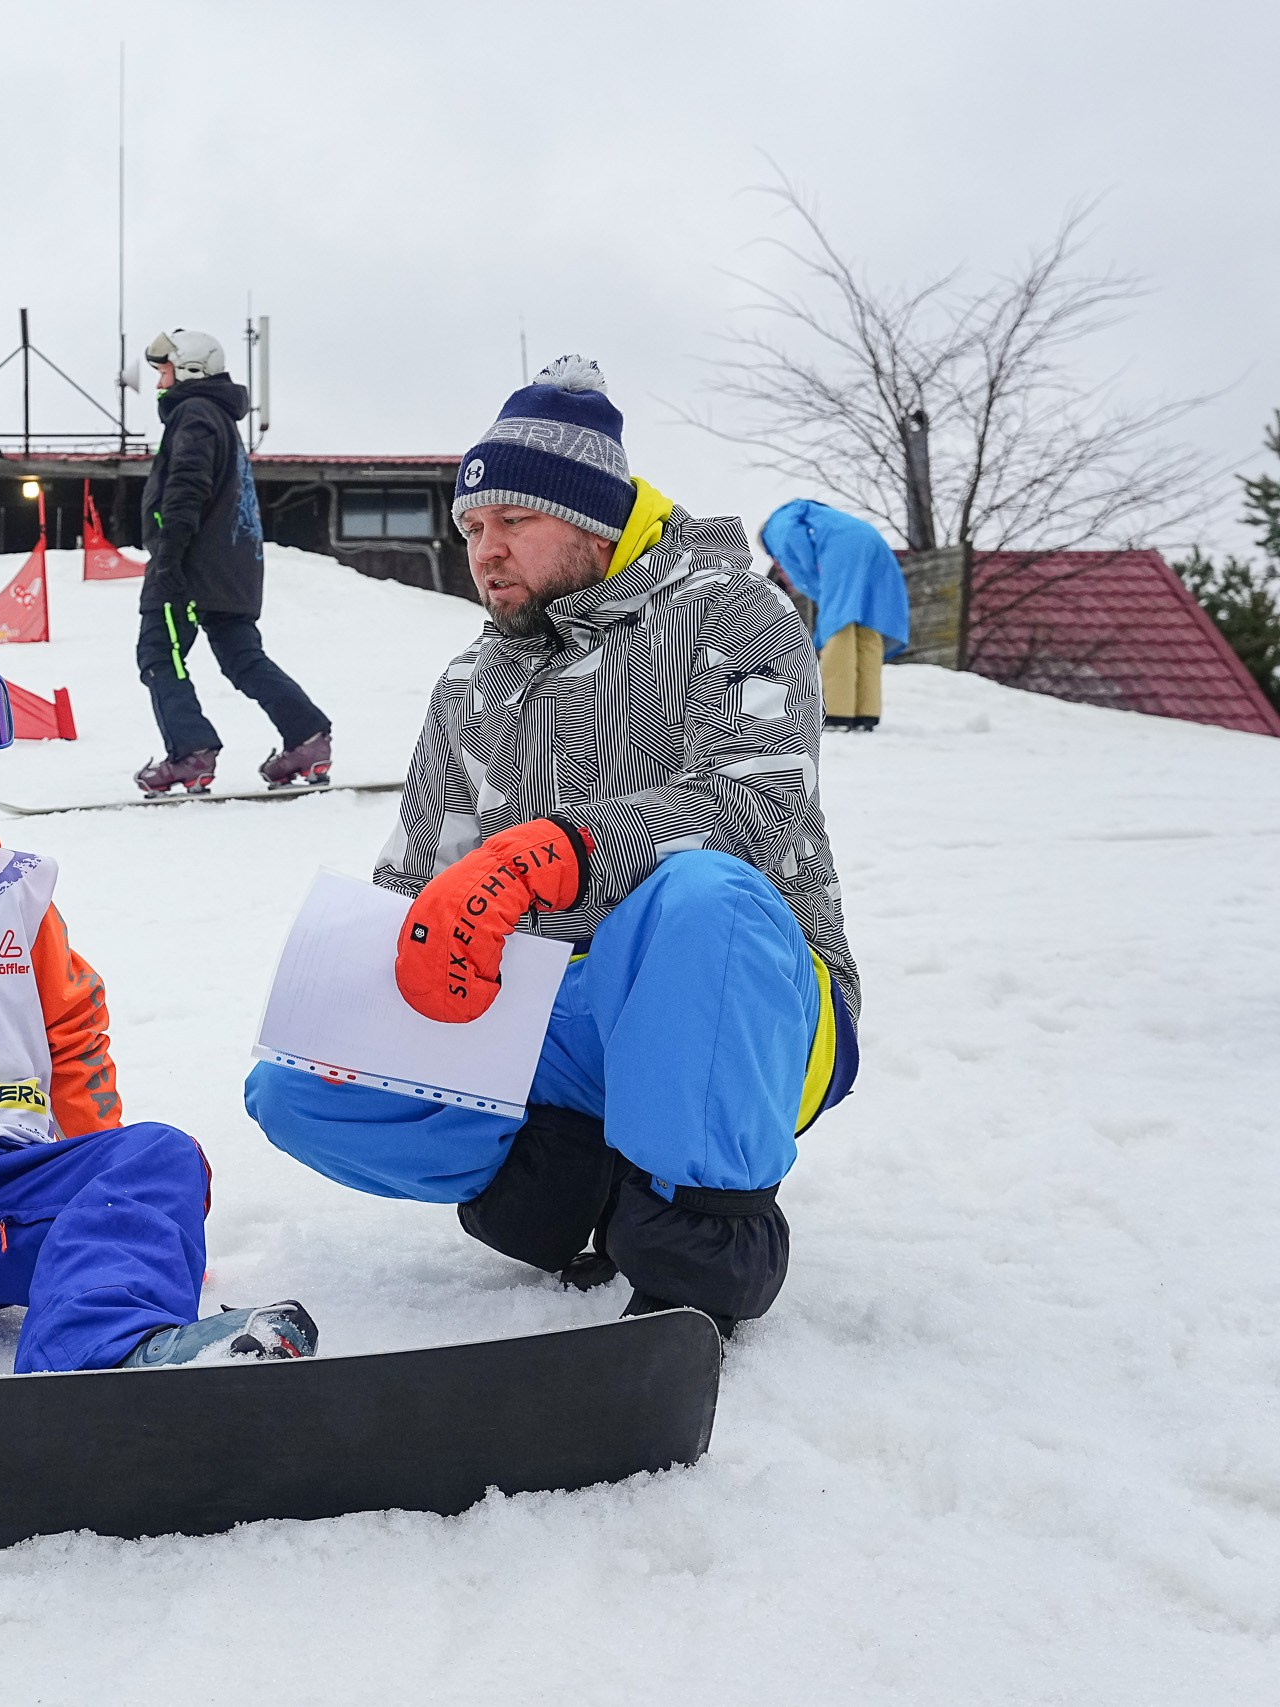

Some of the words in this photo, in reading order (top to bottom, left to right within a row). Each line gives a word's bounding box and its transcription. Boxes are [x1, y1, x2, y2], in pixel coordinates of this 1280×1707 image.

[512, 842, 561, 876] SIX
[452, 865, 517, 946] EIGHT
[448, 952, 468, 999] SIX
